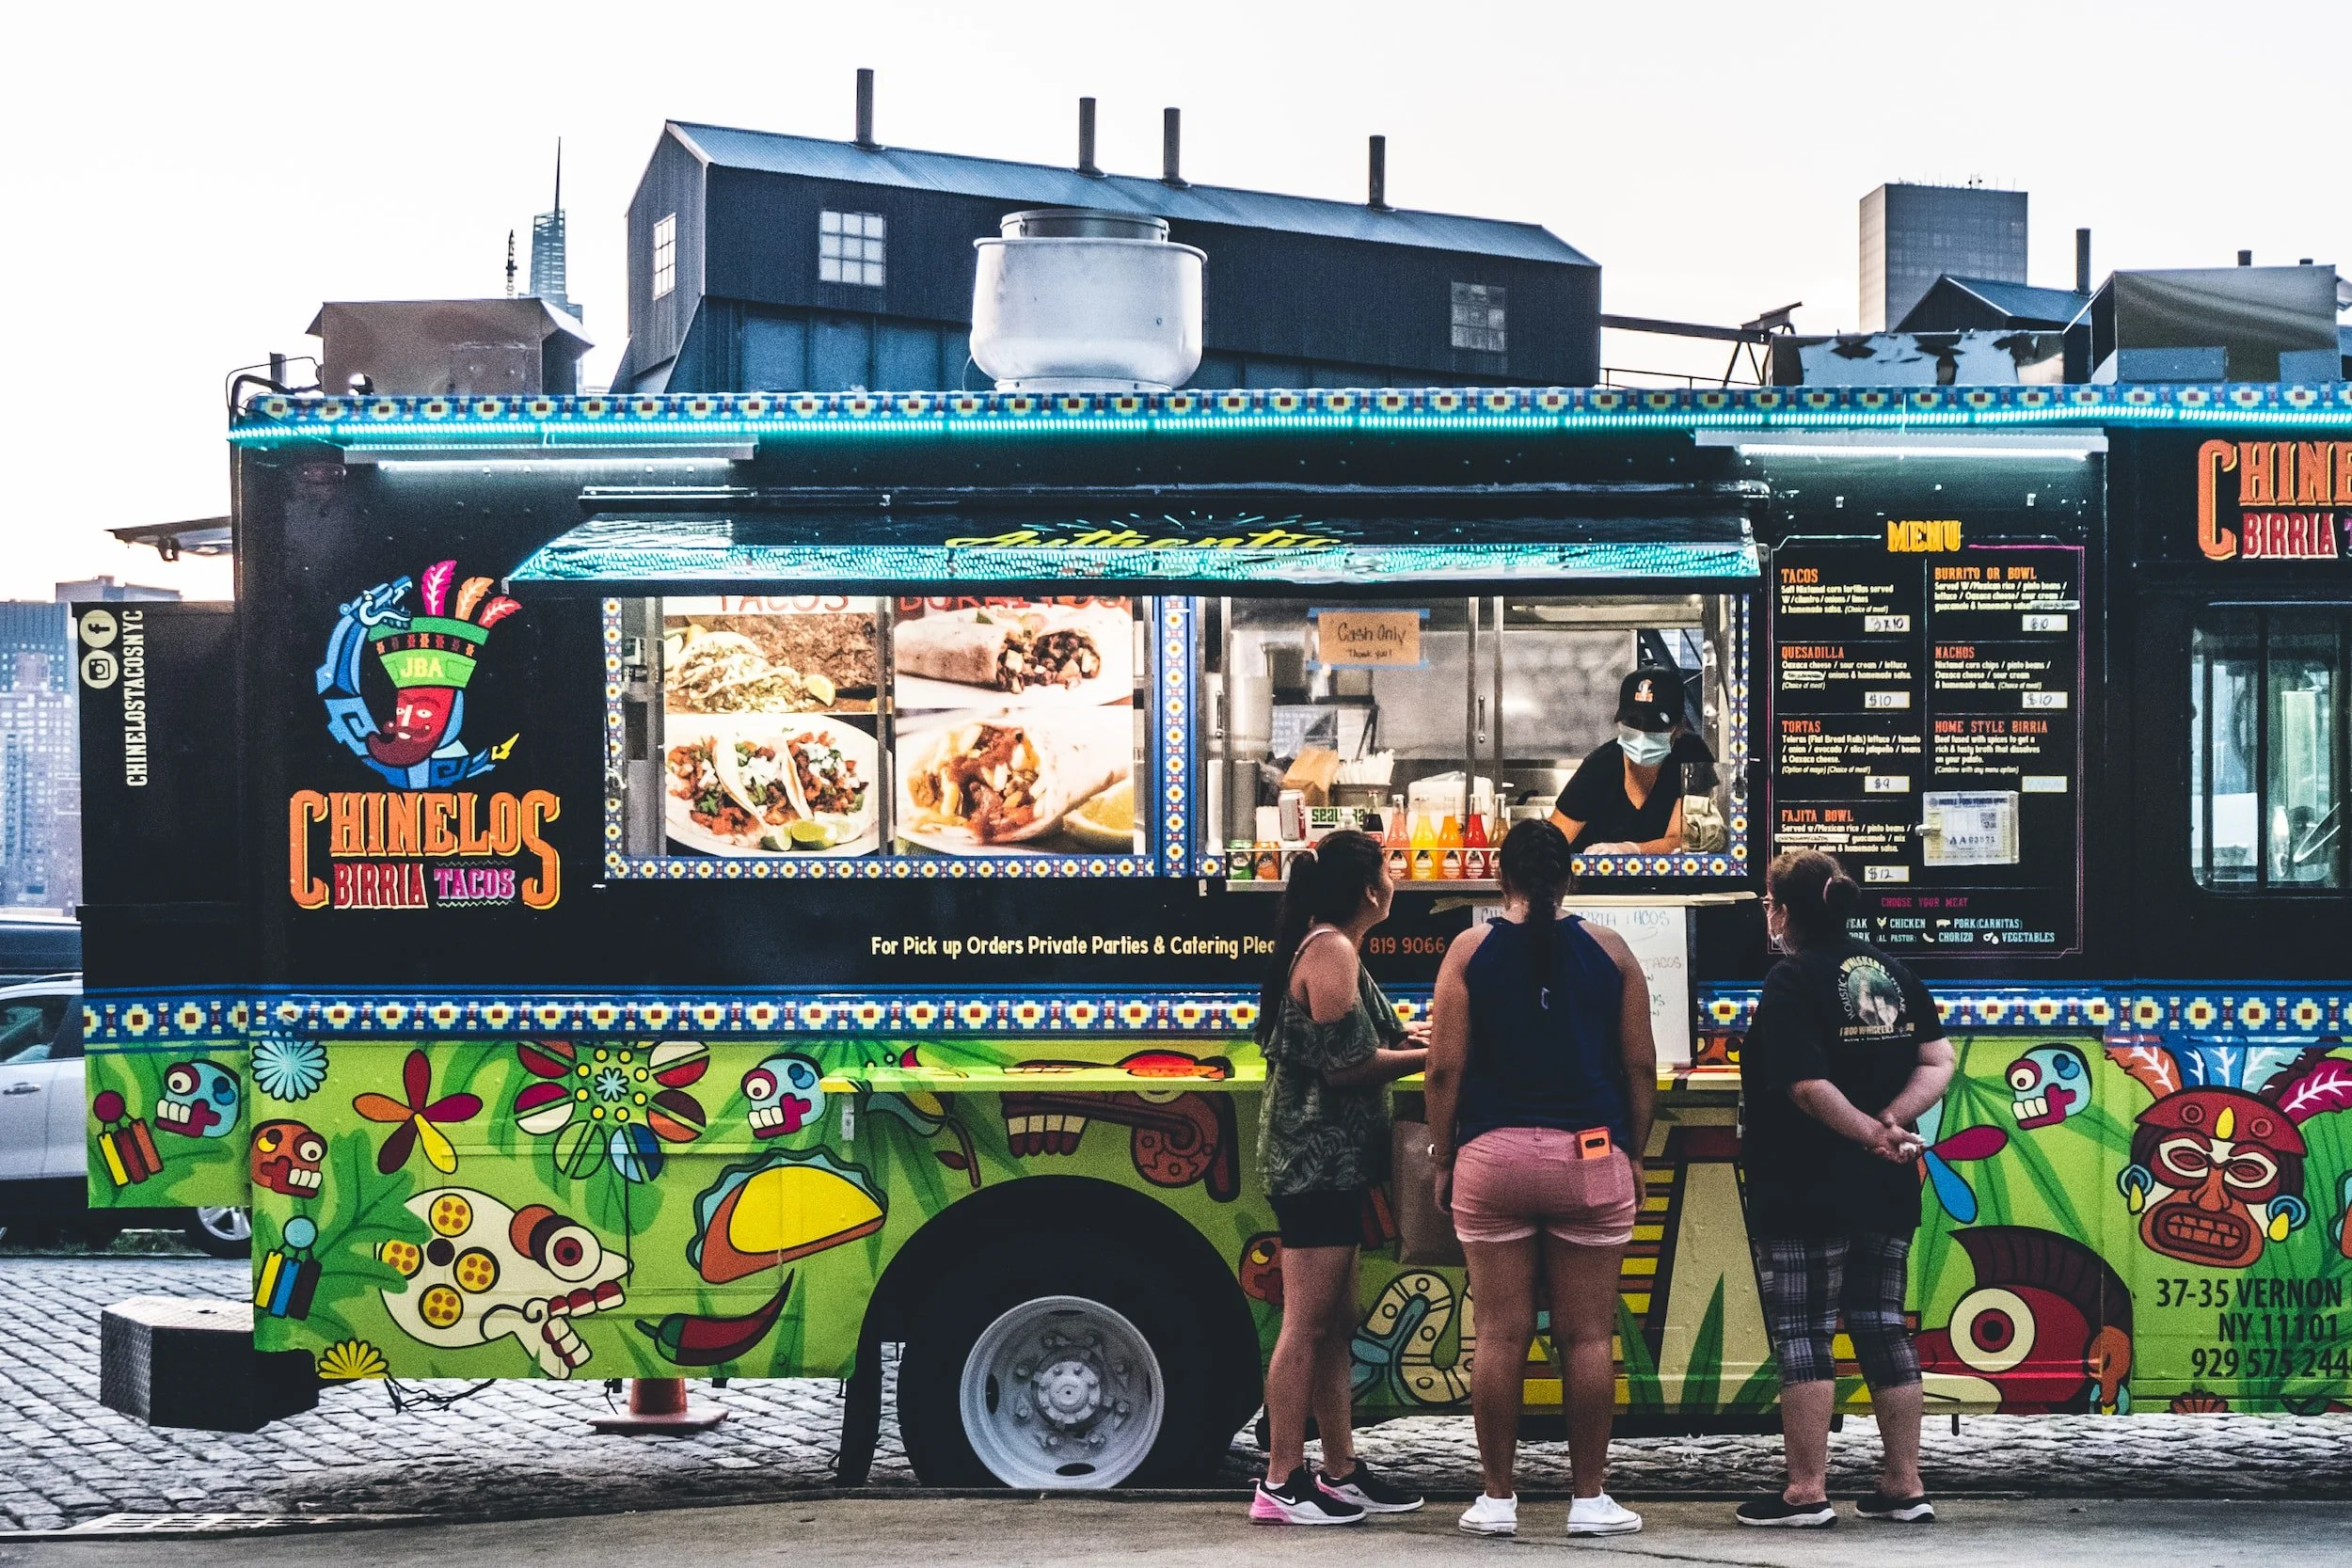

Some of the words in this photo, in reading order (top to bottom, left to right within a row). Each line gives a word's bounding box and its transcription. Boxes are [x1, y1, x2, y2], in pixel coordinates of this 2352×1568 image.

[1886, 520, 1962, 552] MENU
[2242, 513, 2338, 559] BIRRIA
[1781, 569, 1818, 583] TACOS
[1934, 567, 1980, 580] BURRITO
[1987, 567, 2000, 580] OR
[2008, 567, 2037, 580] BOWL
[1827, 585, 1842, 594] corn
[1870, 585, 1894, 594] served
[1934, 581, 1959, 590] Served
[1338, 623, 1373, 642] Cash
[1377, 624, 1406, 646] Only
[1781, 646, 1844, 659] QUESADILLA
[1934, 646, 1975, 658] NACHOS
[401, 658, 443, 677] JBA
[1981, 661, 1999, 671] chips
[2007, 661, 2024, 671] pinto
[1858, 671, 1892, 679] homemade
[122, 611, 147, 786] CHINELOSTACOSNYC
[1869, 693, 1891, 706] $10
[2026, 693, 2053, 705] $10
[1782, 721, 1820, 733] TORTAS
[1934, 721, 1963, 733] HOME
[1971, 721, 2004, 733] STYLE
[2012, 721, 2047, 733] BIRRIA
[1782, 810, 1817, 822] FAJITA
[1825, 810, 1853, 822] BOWL
[1782, 824, 1806, 832] Served
[1846, 824, 1859, 832] rice
[1867, 824, 1884, 833] pinto
[1885, 824, 1905, 832] beans
[290, 790, 561, 910] CHINELOS
[1868, 867, 1894, 880] $12
[334, 863, 429, 910] BIRRIA
[434, 867, 515, 899] TACOS
[1882, 897, 1912, 907] CHOOSE
[1918, 897, 1940, 907] YOUR
[1946, 897, 1968, 907] MEAT
[1890, 919, 1926, 928] CHICKEN
[1939, 932, 1973, 942] CHORIZO
[2002, 932, 2055, 942] VEGETABLES
[871, 937, 898, 956] For
[904, 936, 937, 955] Pick
[943, 939, 962, 959] up
[967, 936, 1024, 955] Orders
[1028, 936, 1088, 955] Private
[1092, 936, 1149, 955] Parties
[1153, 936, 1166, 955] &
[1170, 936, 1238, 959] Catering
[1369, 937, 1396, 954] 819
[1402, 937, 1445, 954] 9066
[2156, 1278, 2229, 1307] 37-35
[2236, 1278, 2342, 1307] VERNON
[2219, 1313, 2252, 1342] NY
[2262, 1314, 2338, 1342] 11101
[2191, 1348, 2239, 1378] 929
[2246, 1348, 2293, 1378] 575
